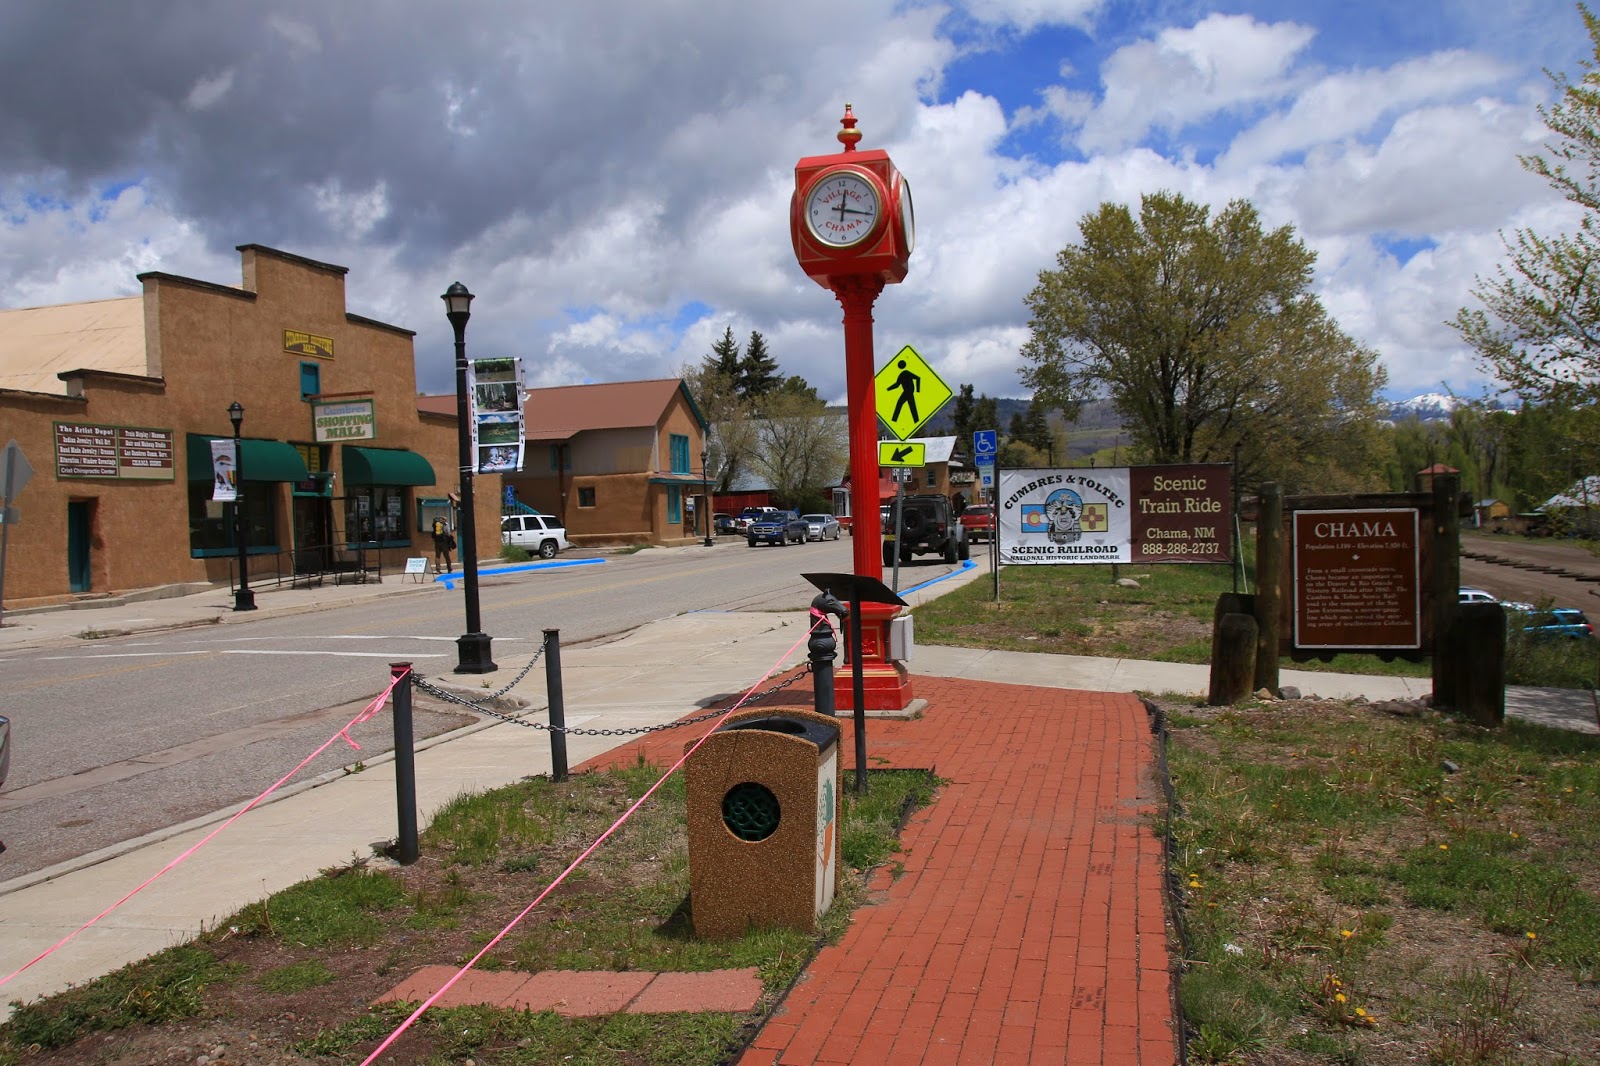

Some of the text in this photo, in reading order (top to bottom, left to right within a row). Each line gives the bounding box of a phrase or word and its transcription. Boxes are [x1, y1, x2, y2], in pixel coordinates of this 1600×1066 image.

[823, 189, 862, 204] VILLAGE
[826, 219, 862, 231] CHAMA
[324, 405, 365, 415] Cumbres
[316, 414, 372, 428] SHOPPING
[95, 428, 113, 436] Depot
[326, 426, 365, 439] MALL
[1154, 475, 1206, 491] Scenic
[1004, 475, 1062, 510] CUMBRES
[1078, 477, 1125, 508] TOLTEC
[1140, 498, 1221, 513] Train Ride
[1147, 527, 1215, 539] Chama, NM
[1315, 522, 1397, 537] CHAMA
[1142, 543, 1219, 554] 888-286-2737
